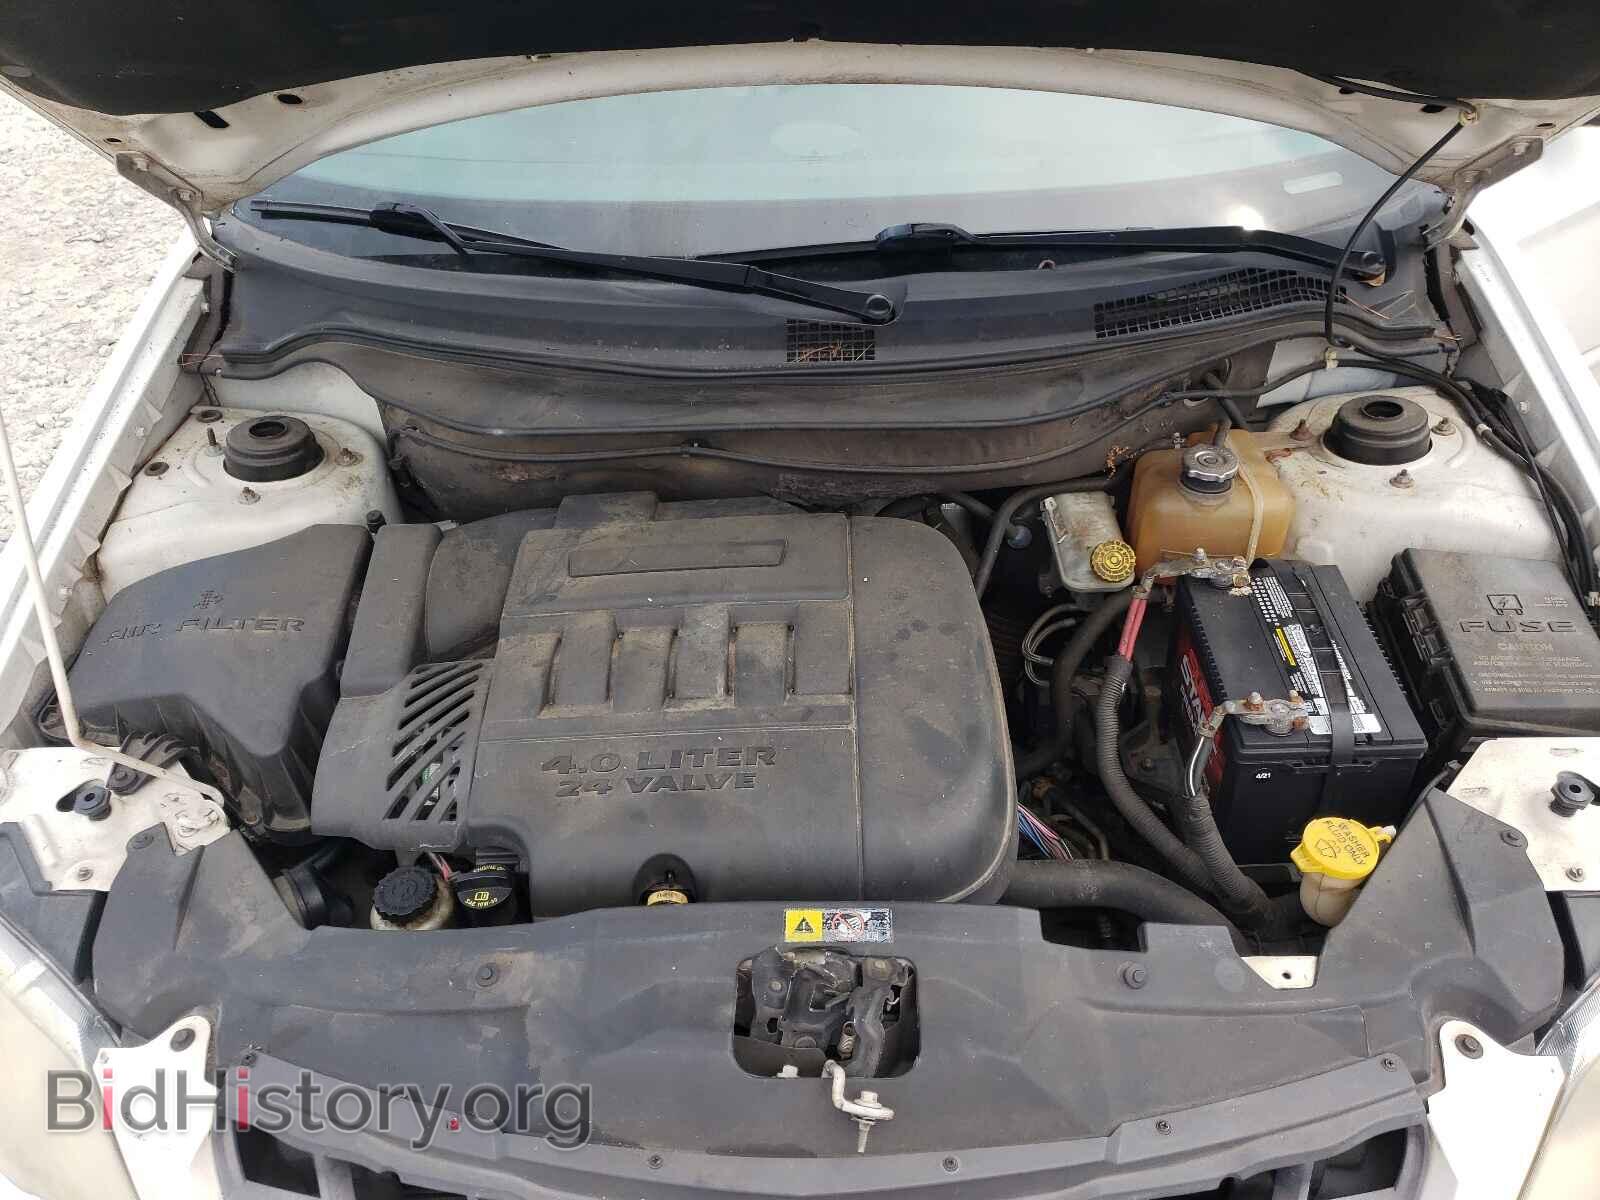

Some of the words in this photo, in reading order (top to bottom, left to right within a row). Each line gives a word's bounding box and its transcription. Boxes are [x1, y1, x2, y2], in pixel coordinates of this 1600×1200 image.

[175, 616, 305, 633] FILTER
[1459, 620, 1577, 633] FUSE
[542, 752, 621, 775] 4.0
[637, 747, 777, 771] LITER
[556, 778, 614, 798] 24
[626, 772, 757, 794] VALVE
